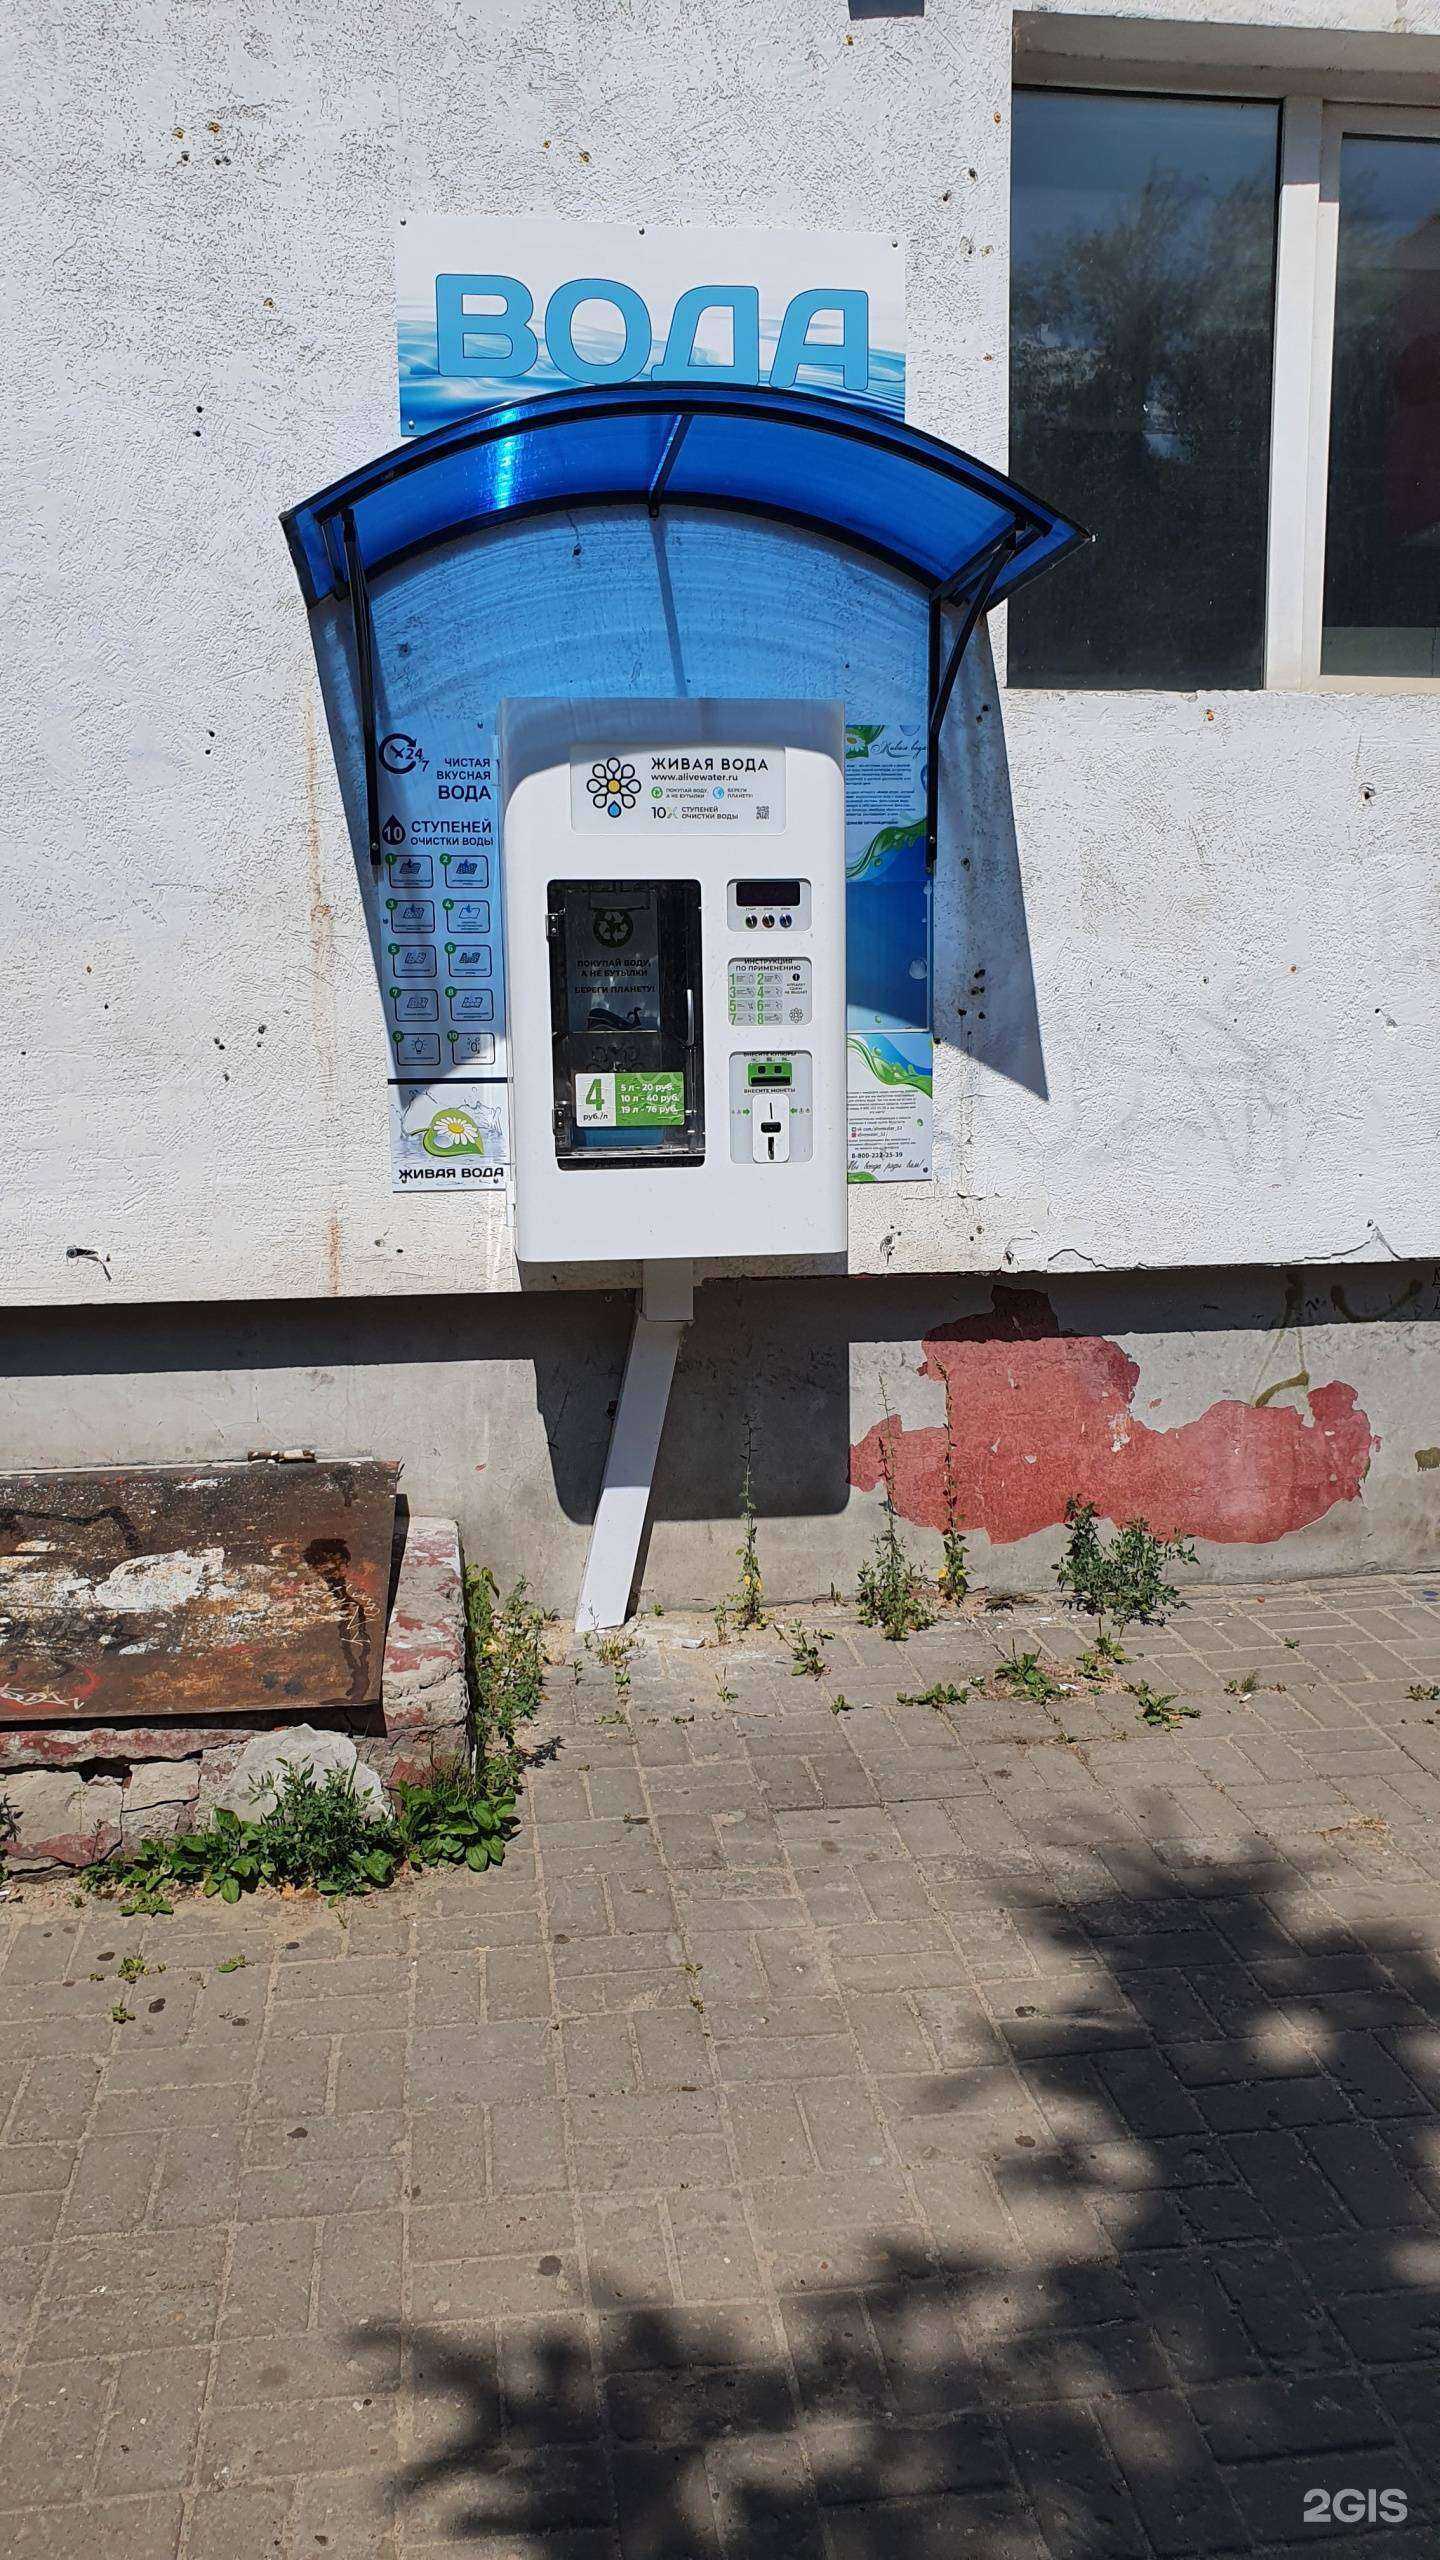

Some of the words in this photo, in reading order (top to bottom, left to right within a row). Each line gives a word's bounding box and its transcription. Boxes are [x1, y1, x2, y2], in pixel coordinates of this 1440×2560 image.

[436, 273, 869, 391] ВОДА
[445, 758, 490, 767] ЧИСТАЯ
[651, 757, 714, 771] ЖИВАЯ
[721, 758, 769, 772] ВОДА
[436, 771, 491, 780] ВКУСНАЯ
[651, 773, 738, 782] www.alivewater.ru
[438, 785, 491, 802] ВОДА
[681, 805, 719, 813] СТУПЕНЕЙ
[411, 817, 492, 833] СТУПЕНЕЙ
[384, 826, 402, 841] 10
[410, 837, 459, 846] ОЧИСТКИ
[462, 837, 494, 847] ВОДЫ
[577, 959, 622, 968] ПОКУПАЙ
[590, 969, 603, 977] НЕ
[604, 969, 648, 977] БУТЫЛКИ
[729, 973, 735, 985] 1
[757, 973, 764, 985] 2
[575, 986, 609, 994] БЕРЕГИ
[610, 985, 656, 993] ПЛАНЕТУ!
[729, 986, 736, 998] 3
[757, 986, 764, 998] 4
[729, 1000, 736, 1012] 5
[757, 1000, 764, 1011] 6
[729, 1013, 736, 1025] 7
[757, 1013, 764, 1024] 8
[621, 1084, 627, 1092] 5
[642, 1083, 653, 1092] 20
[656, 1083, 675, 1092] руб.
[586, 1078, 605, 1111] 4
[621, 1095, 631, 1103] 10
[661, 1094, 680, 1103] руб.
[621, 1106, 631, 1114] 19
[646, 1105, 658, 1113] 76
[660, 1105, 679, 1114] руб.
[583, 1112, 608, 1120] руб./л
[399, 1167, 456, 1179] ЖИВАЯ
[461, 1167, 504, 1178] ВОДА
